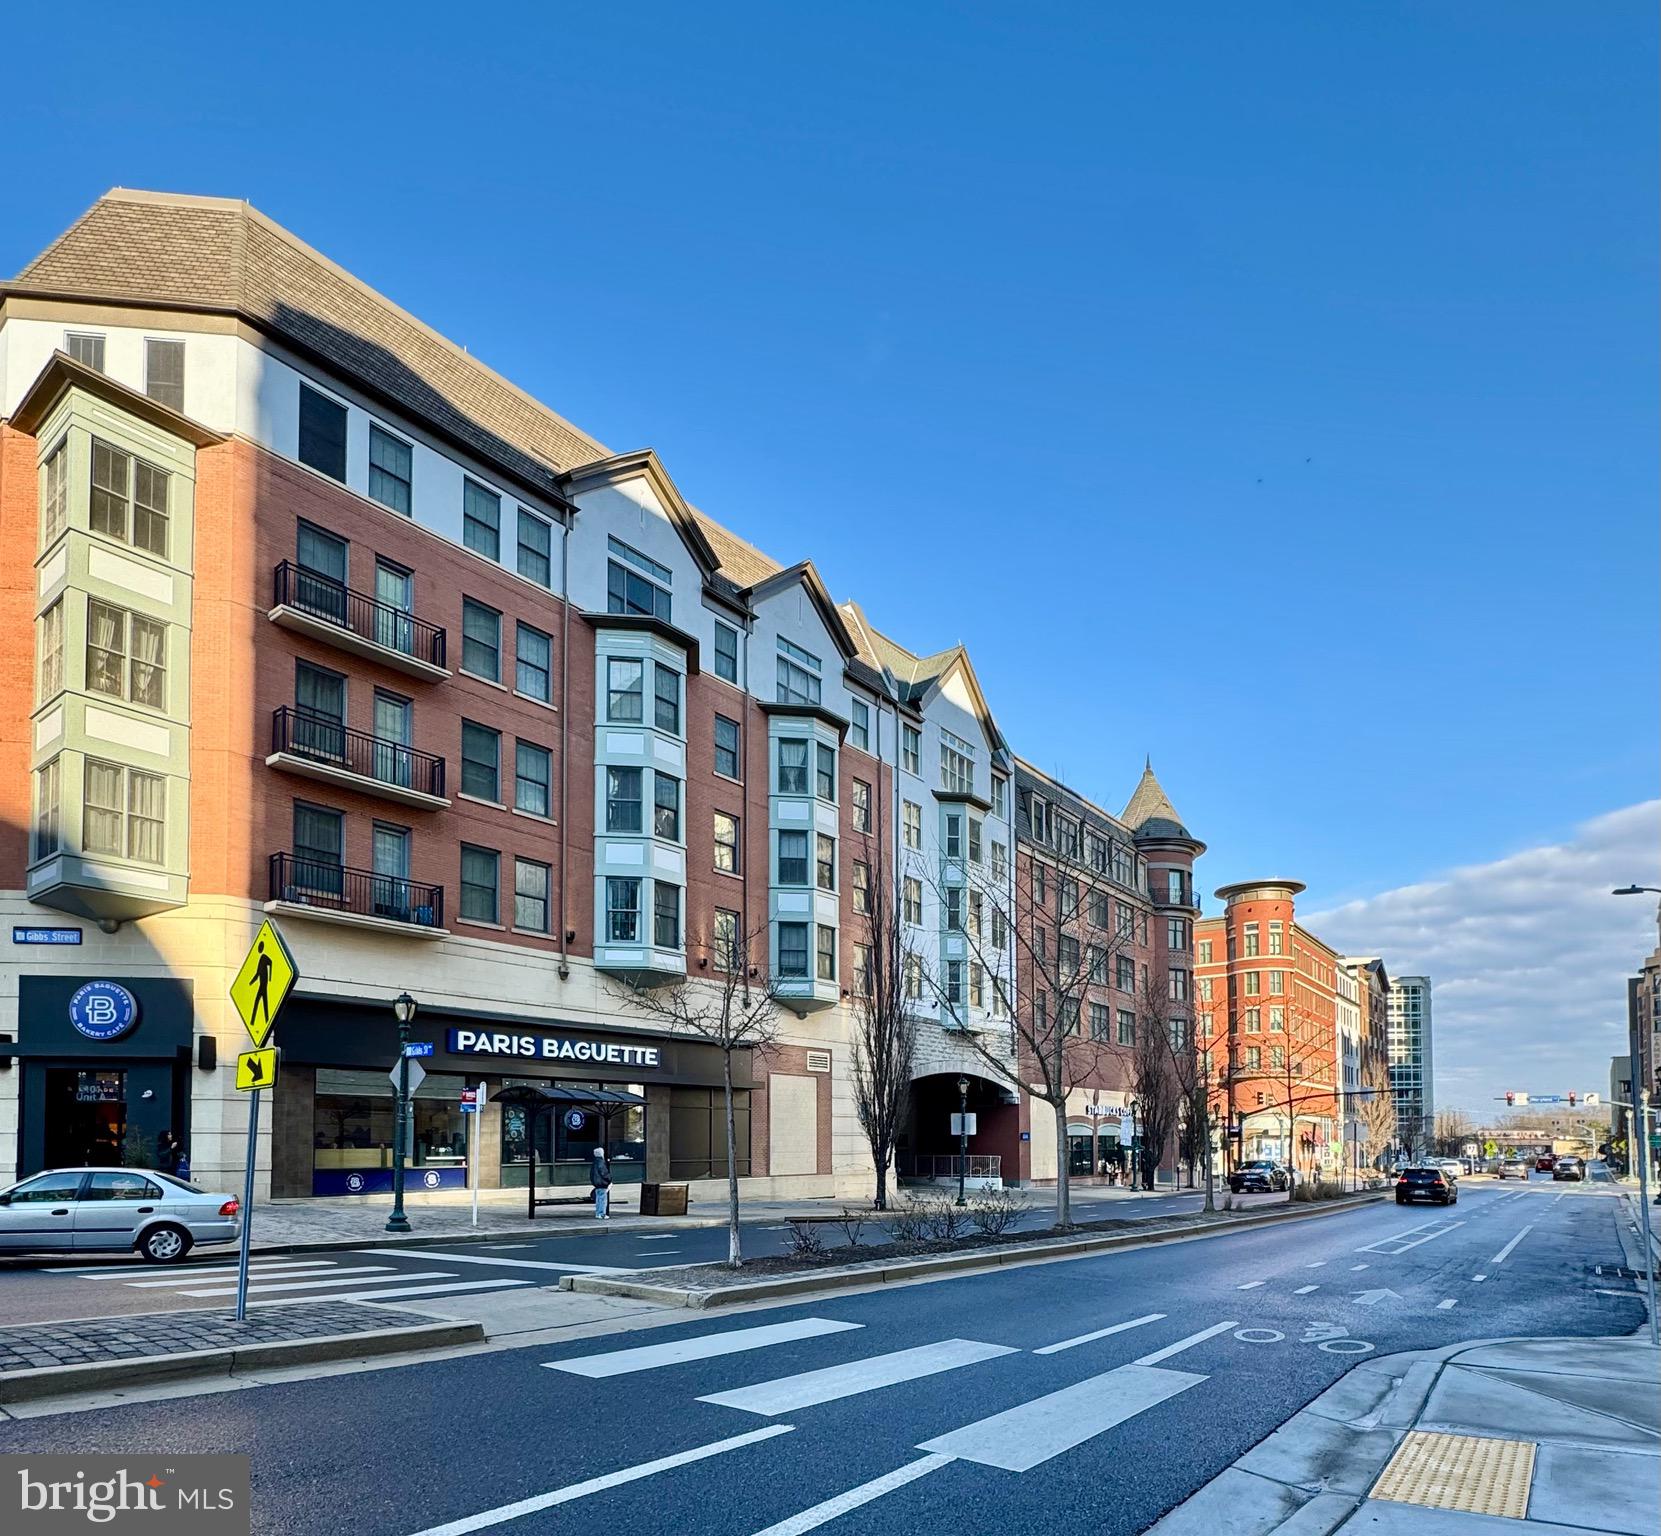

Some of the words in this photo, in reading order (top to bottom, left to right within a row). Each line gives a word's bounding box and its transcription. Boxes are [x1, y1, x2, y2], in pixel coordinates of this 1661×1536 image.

[26, 932, 49, 941] Gibbs
[51, 931, 78, 942] Street
[73, 985, 92, 1005] PARIS
[94, 983, 129, 1006] BAGUETTE
[77, 1022, 106, 1037] BAKERY
[457, 1030, 536, 1056] PARIS
[542, 1038, 659, 1066] BAGUETTE
